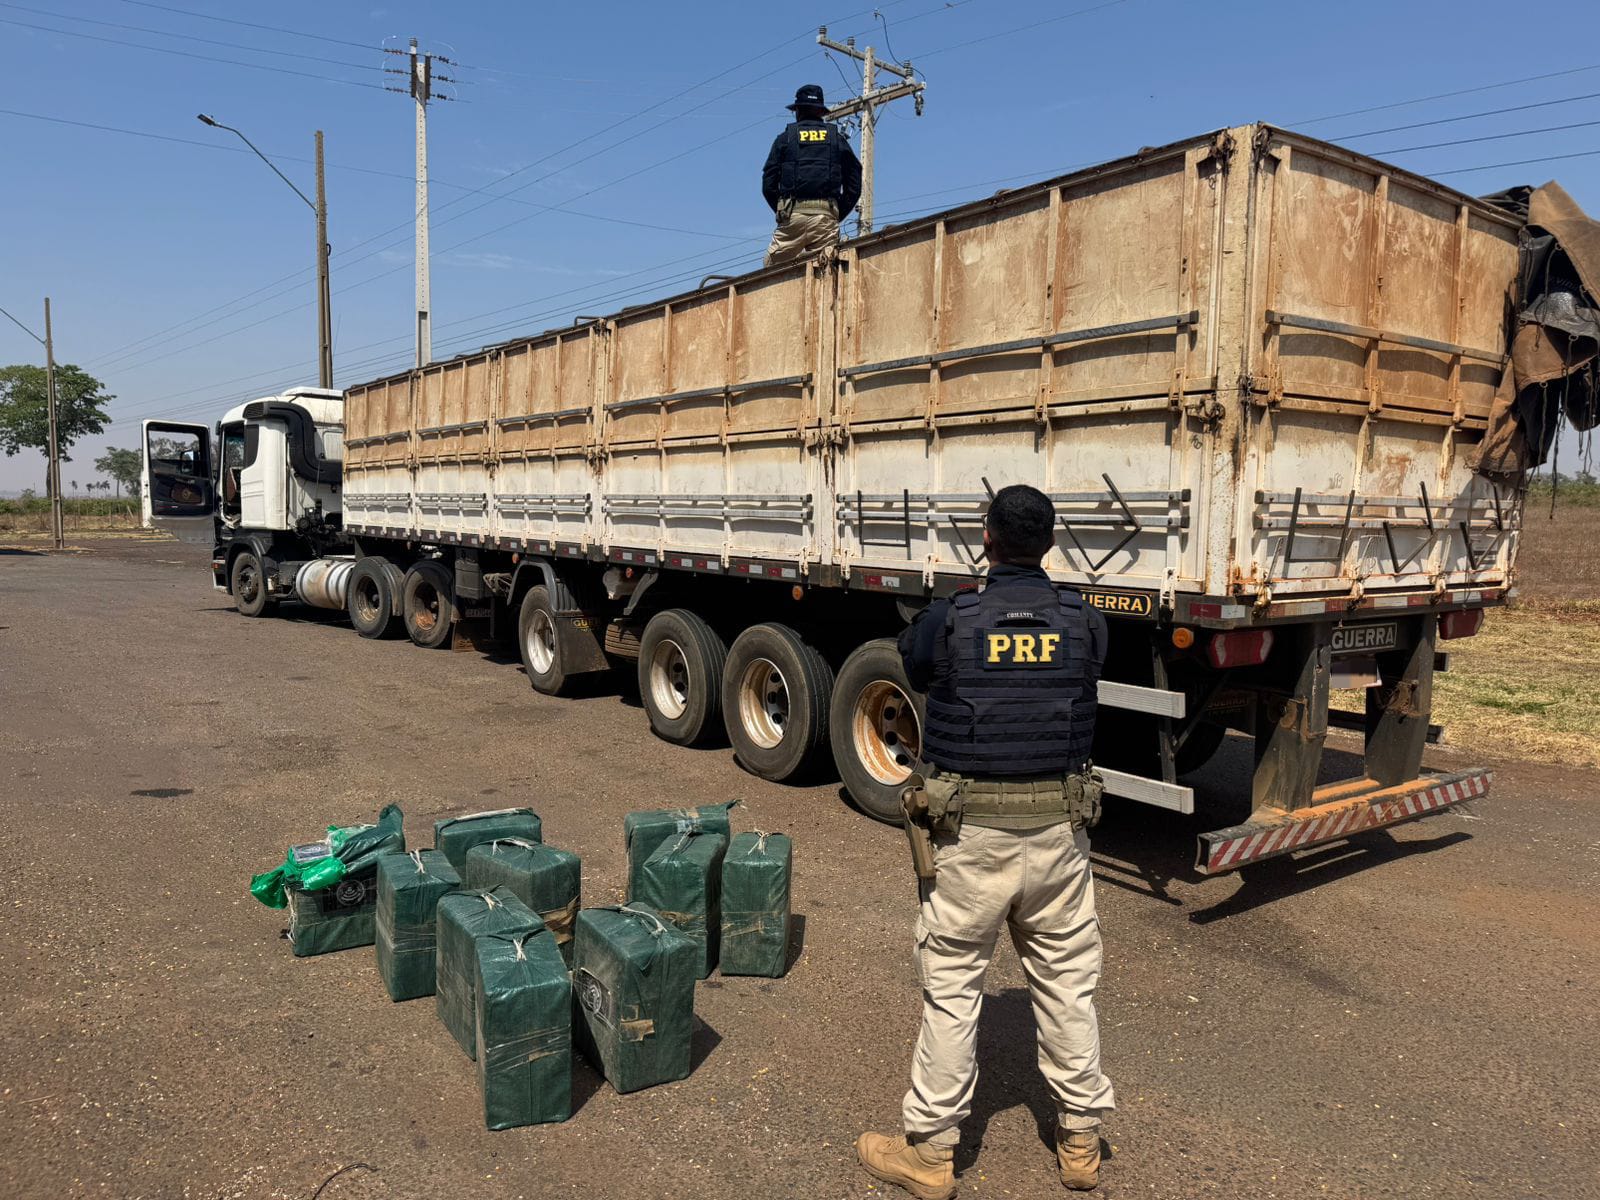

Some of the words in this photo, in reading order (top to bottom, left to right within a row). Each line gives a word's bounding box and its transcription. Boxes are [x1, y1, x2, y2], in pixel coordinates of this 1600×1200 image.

[799, 130, 827, 142] PRF
[1082, 593, 1144, 612] UERRA
[986, 633, 1061, 663] PRF
[1331, 626, 1394, 650] GUERRA
